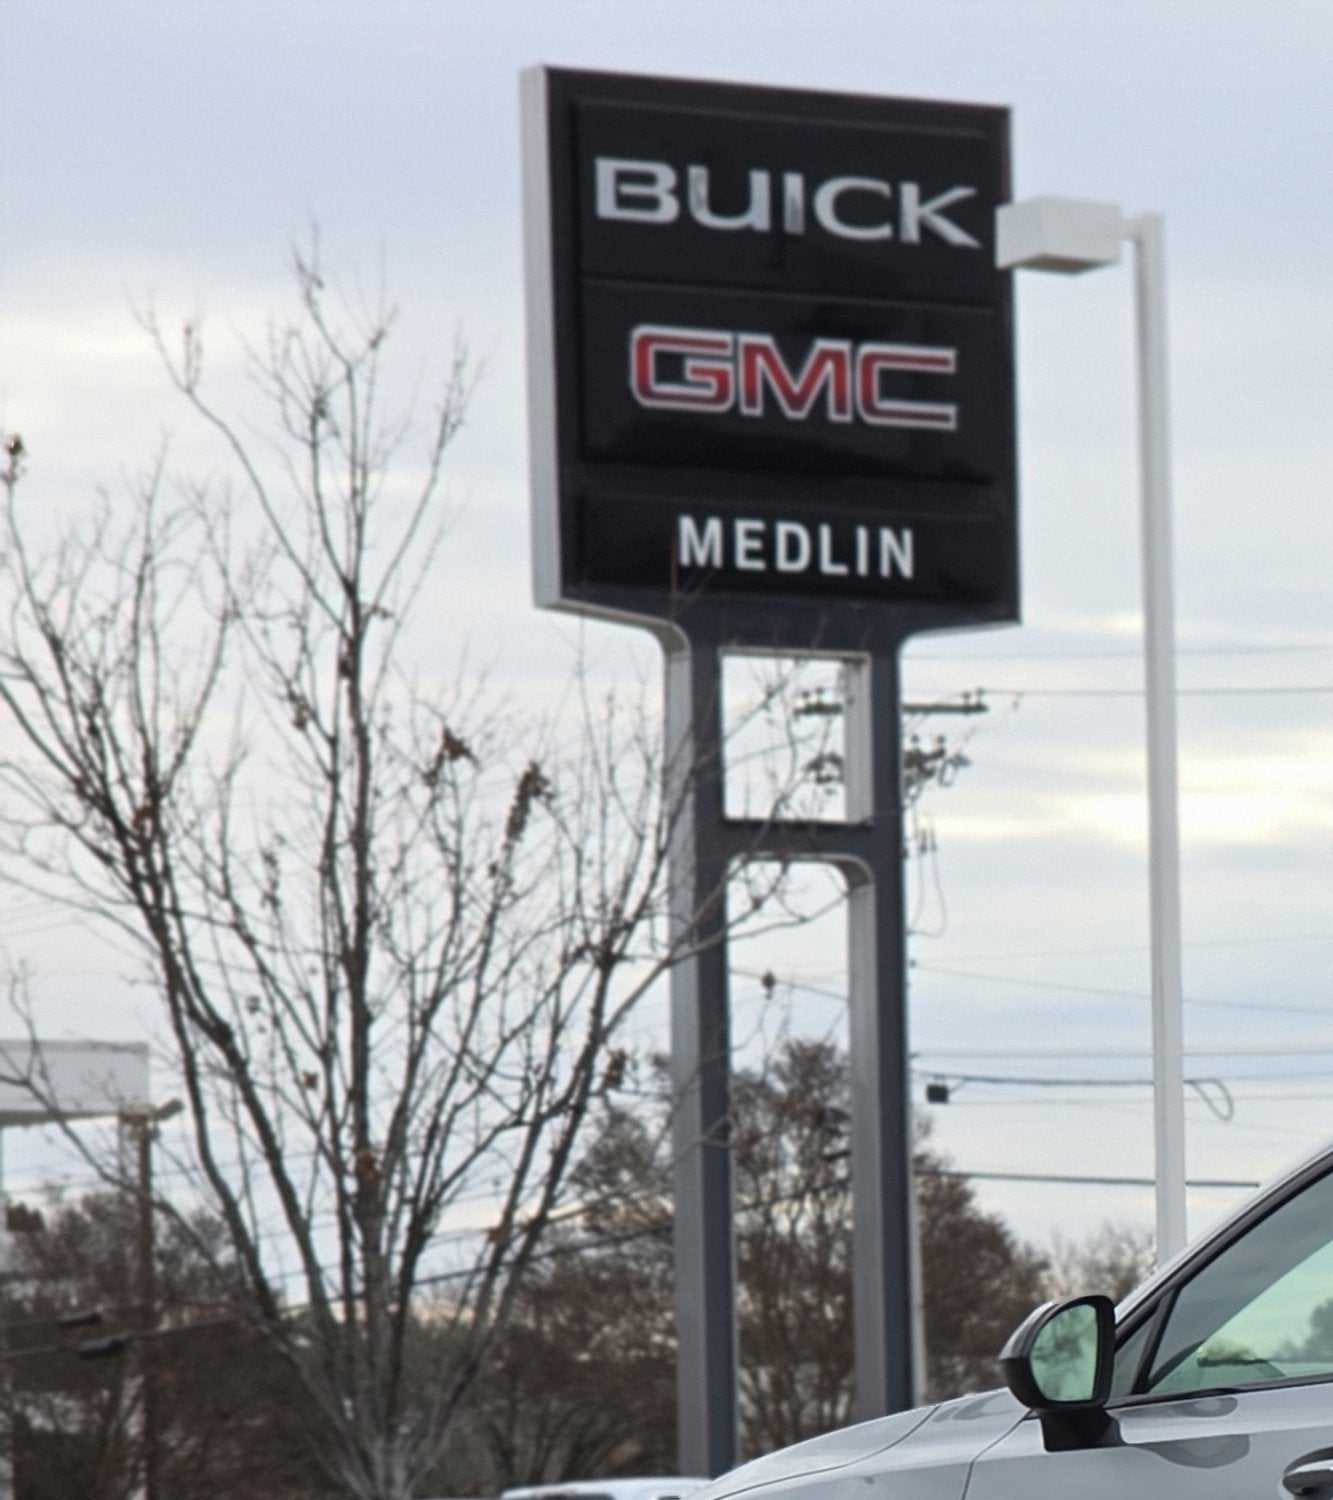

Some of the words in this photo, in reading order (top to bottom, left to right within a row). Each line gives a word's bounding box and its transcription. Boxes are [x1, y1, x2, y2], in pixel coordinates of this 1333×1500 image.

[593, 155, 981, 249] BUICK
[630, 323, 958, 431] GMC
[678, 514, 914, 579] MEDLIN
